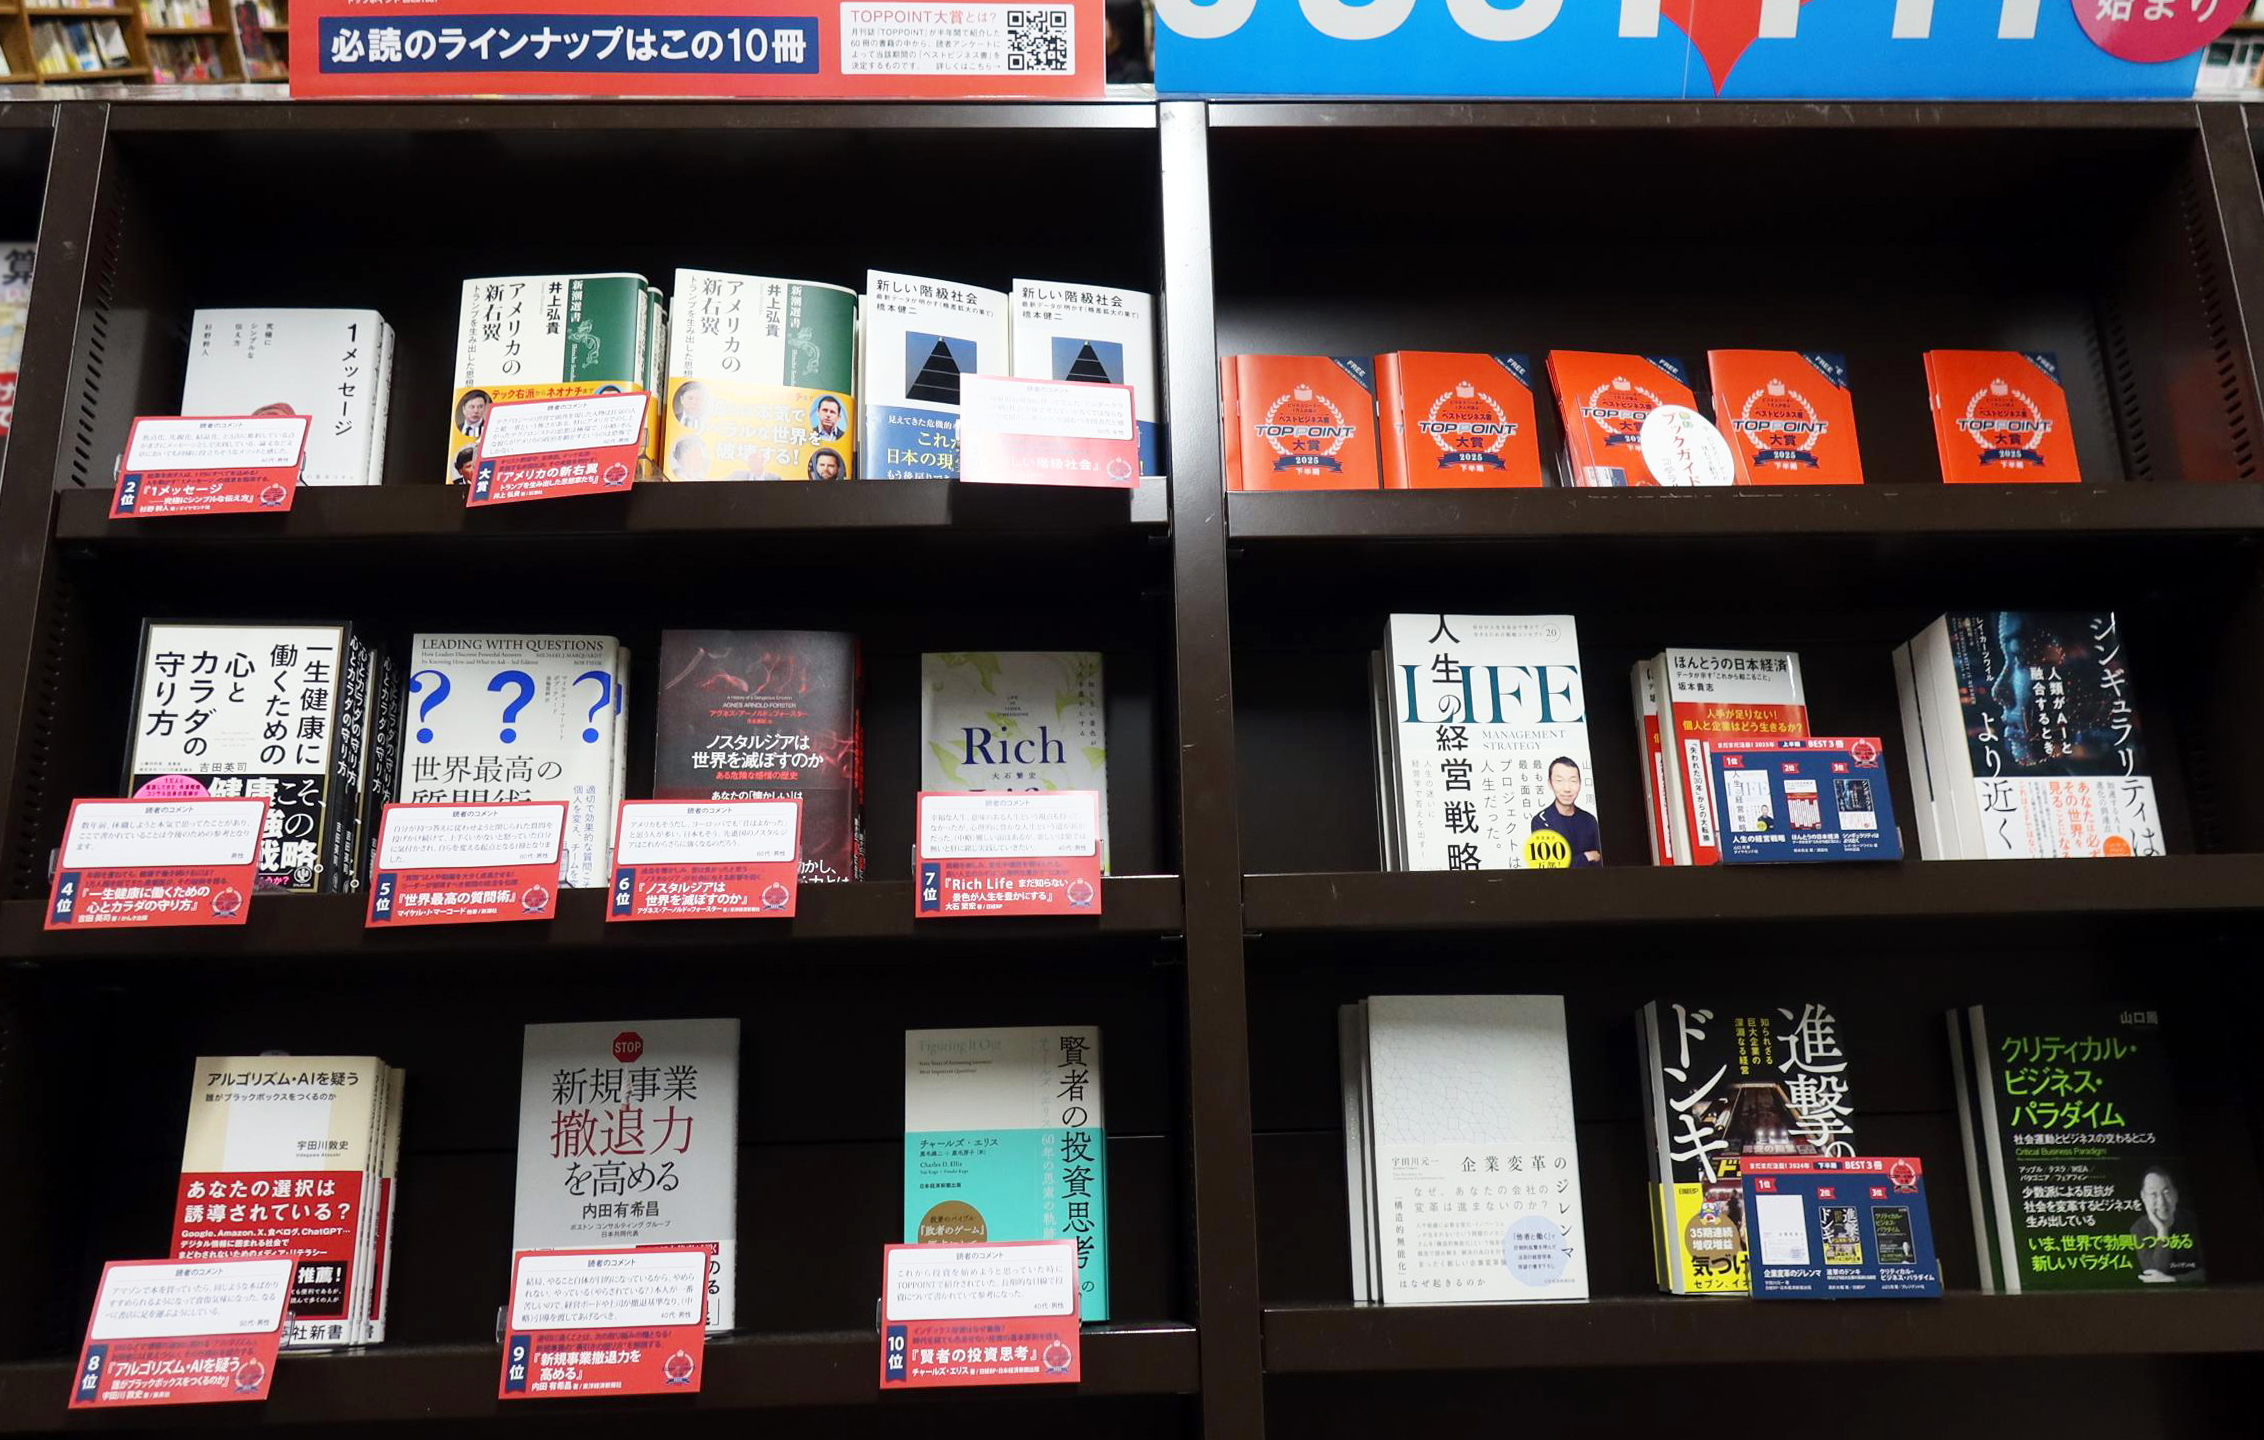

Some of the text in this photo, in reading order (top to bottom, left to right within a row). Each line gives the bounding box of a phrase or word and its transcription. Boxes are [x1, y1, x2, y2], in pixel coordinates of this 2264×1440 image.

[331, 26, 807, 63] 必読のラインナップはこの10冊
[876, 279, 979, 306] 新しい階級社会
[1022, 287, 1124, 307] 新しい階級社会
[482, 282, 505, 342] 新右翼
[547, 282, 562, 335] 井上弘貴
[700, 278, 723, 336] 新右翼
[765, 284, 781, 337] 井上弘貴
[502, 282, 526, 376] アメリカの
[722, 280, 744, 373] アメリカの
[1346, 358, 1367, 378] FREE
[1506, 356, 1528, 376] FREE
[335, 323, 359, 437] 1メッセージ
[1254, 424, 1357, 439] TOPPOINT
[1417, 421, 1518, 436] TOPPOINT
[1730, 419, 1828, 434] TOPPOINT
[1292, 439, 1320, 451] 大賞
[1456, 436, 1483, 448] 大賞
[1295, 456, 1320, 464] 2025
[1459, 453, 1483, 461] 2025
[1773, 451, 1796, 460] 2025
[422, 639, 604, 652] LEADING WITH QUESTIONS
[1674, 656, 1788, 673] ほんとうの日本経済
[225, 652, 256, 704] 心と
[145, 651, 186, 736] 守り方
[184, 650, 218, 757] カラダの
[1397, 664, 1585, 724] LIFE
[260, 643, 298, 766] 働くための
[295, 646, 334, 765] 一生健康に
[2030, 667, 2055, 754] 融合するとき
[2048, 667, 2073, 755] 人類がAIと
[706, 734, 810, 751] ノスタルジアは
[1428, 614, 1482, 871] 人生の経営戦略
[1482, 730, 1566, 740] MANAGEMENT
[2089, 611, 2161, 857] シンギュラリティは
[961, 726, 1067, 765] Rich
[1483, 742, 1542, 751] STRATEGY
[199, 762, 247, 773] 吉田英司
[411, 755, 563, 784] 世界最高の
[692, 752, 824, 770] 世界を滅ぼすのか
[1977, 712, 2017, 850] より近く
[1481, 760, 1503, 851] 人生だった。
[1500, 761, 1522, 869] プロジェクトは
[1529, 841, 1566, 861] 100
[638, 882, 726, 894] 『ノスタルジアは
[987, 878, 1013, 889] Life
[87, 901, 198, 912] 心とカラダの守り方』
[398, 890, 517, 905] 『世界最高の質問術』
[645, 894, 749, 906] 世界を滅ぼすのか』
[615, 1041, 642, 1053] STOP
[1747, 1018, 1761, 1065] 巨大企業の
[2001, 1036, 2137, 1063] クリティカル・
[207, 1072, 359, 1086] アルゴリズム・AIを疑う
[552, 1065, 698, 1105] 新規事業
[2005, 1068, 2103, 1098] ビジネス・
[1664, 1003, 1729, 1184] ドンキ
[2011, 1101, 2126, 1129] パラダイム
[550, 1105, 694, 1159] 撤退力
[1461, 1155, 1567, 1173] 企業変革の
[186, 1179, 335, 1199] あなたの選択は
[565, 1160, 680, 1198] を高める
[183, 1203, 351, 1223] 誘導されている?
[583, 1201, 660, 1219] 内田有希昌
[1555, 1178, 1575, 1258] ジレンマ
[2025, 1215, 2096, 1228] 生み出している
[1689, 1227, 1733, 1238] 35期連続
[2031, 1255, 2133, 1273] 新しいパラダイム
[297, 1266, 342, 1284] 推薦!
[532, 1349, 642, 1367] 『新規事業撤退力を
[912, 1345, 1038, 1364] 『賢者の投資思考』
[540, 1367, 584, 1381] 高める』
